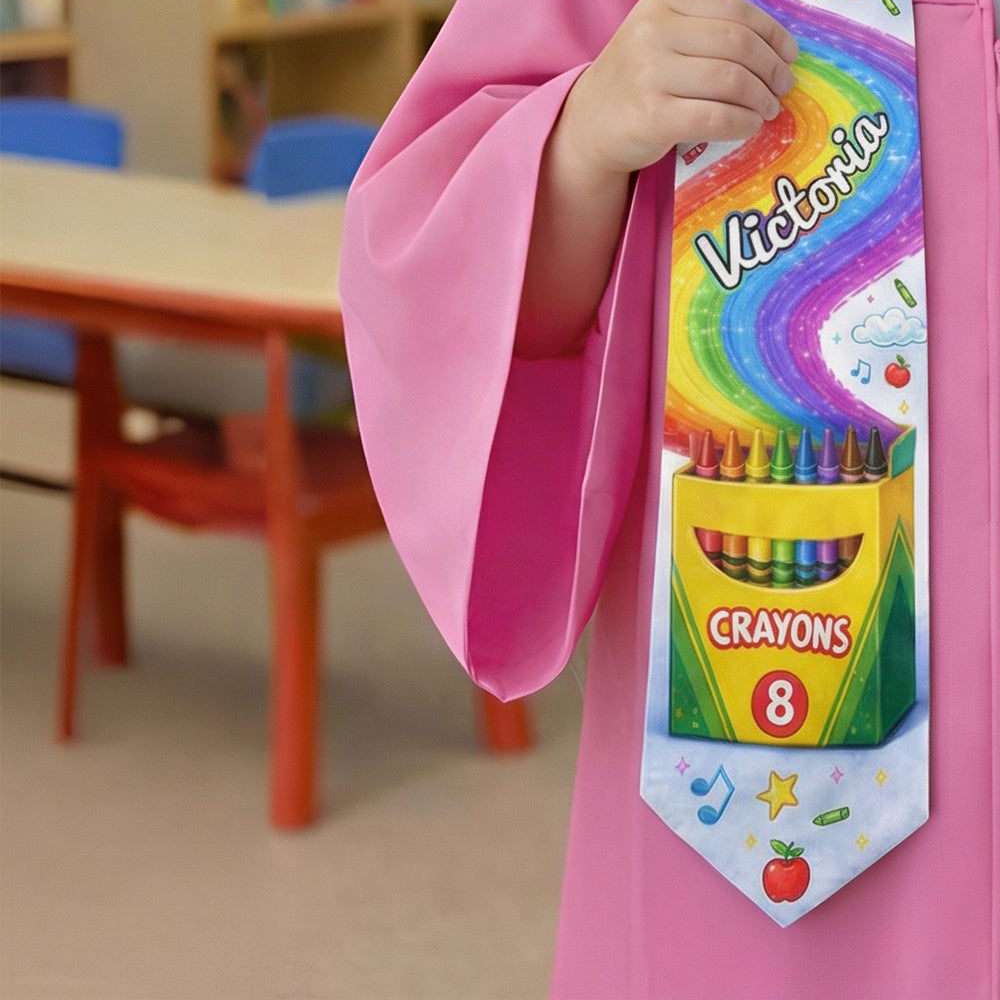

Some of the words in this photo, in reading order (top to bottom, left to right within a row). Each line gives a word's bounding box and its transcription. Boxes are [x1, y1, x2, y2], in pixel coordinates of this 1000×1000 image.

[694, 111, 891, 290] Victoria
[708, 608, 852, 658] CRAYONS
[765, 679, 795, 726] 8
